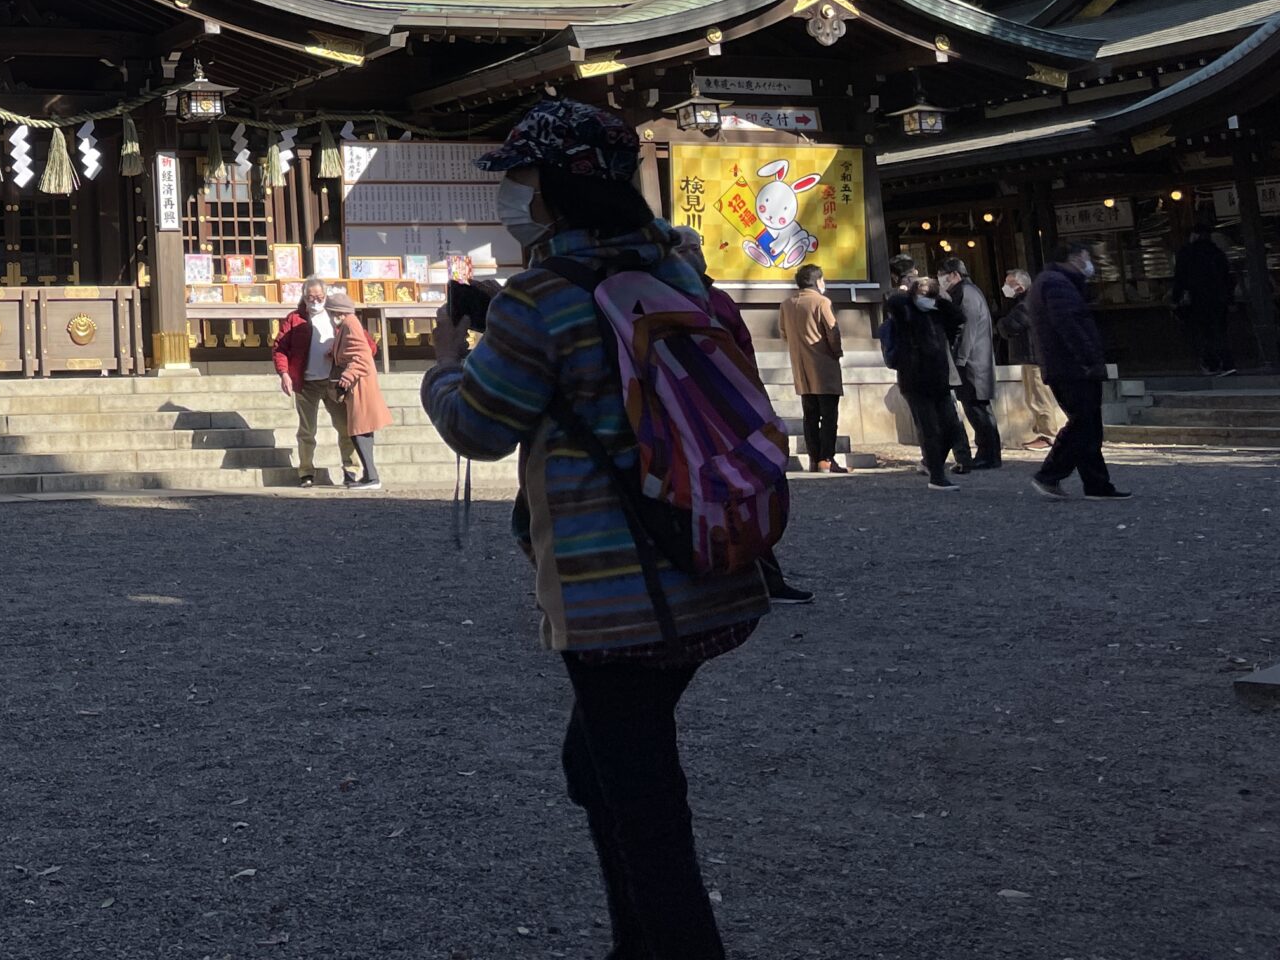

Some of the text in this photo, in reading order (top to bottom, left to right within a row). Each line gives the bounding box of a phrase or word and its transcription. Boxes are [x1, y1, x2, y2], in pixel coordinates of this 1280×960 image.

[840, 161, 852, 205] 令和五年
[680, 176, 706, 247] 検見川
[728, 193, 758, 228] 招福
[822, 184, 838, 230] 癸卯歳
